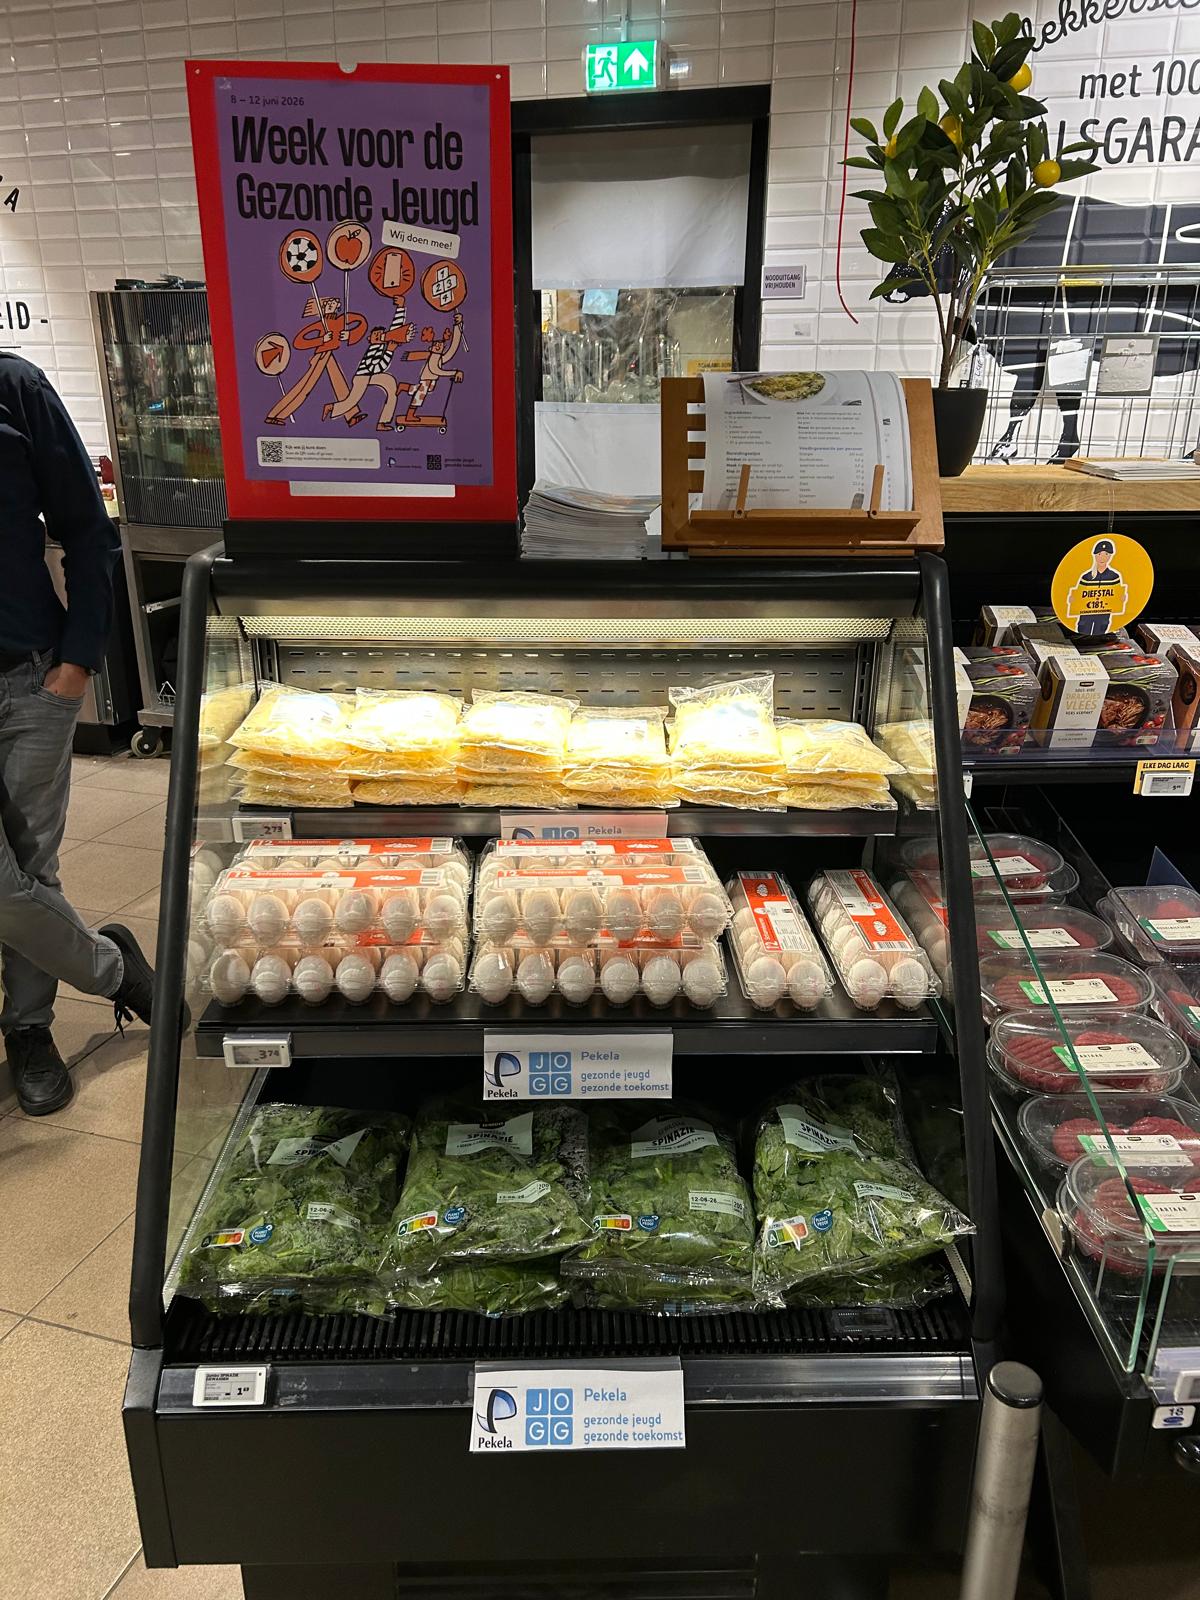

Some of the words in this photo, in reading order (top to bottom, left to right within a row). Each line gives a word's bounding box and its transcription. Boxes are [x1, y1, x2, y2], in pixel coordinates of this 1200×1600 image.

[1079, 64, 1142, 99] met
[231, 94, 237, 104] 8
[249, 95, 260, 105] 12
[262, 96, 279, 107] juni
[281, 97, 305, 106] 2026
[232, 115, 328, 166] Week
[337, 126, 414, 170] voor
[424, 122, 463, 170] de
[236, 172, 373, 222] Gezonde
[381, 178, 479, 236] Jeugd
[389, 229, 405, 242] Wij
[407, 233, 429, 245] doen
[431, 239, 453, 250] mee!
[765, 273, 801, 281] NOODUITGANG
[765, 281, 796, 290] VRIJHOUDEN
[1082, 589, 1114, 598] DIEFSTAL
[1065, 700, 1097, 710] VLEES
[588, 826, 622, 835] Pekela
[580, 1051, 620, 1061] Pekela
[580, 1070, 621, 1082] gezonde
[623, 1069, 650, 1081] jeugd
[487, 1088, 518, 1098] Pekela
[580, 1083, 621, 1094] gezonde
[623, 1082, 669, 1092] toekomst
[770, 1233, 776, 1243] A
[583, 1387, 627, 1401] Pekela
[583, 1415, 629, 1428] gezonde
[631, 1413, 662, 1428] jeugd
[477, 1436, 513, 1449] Pekela
[583, 1431, 629, 1444] gezonde
[632, 1430, 683, 1441] toekomst
